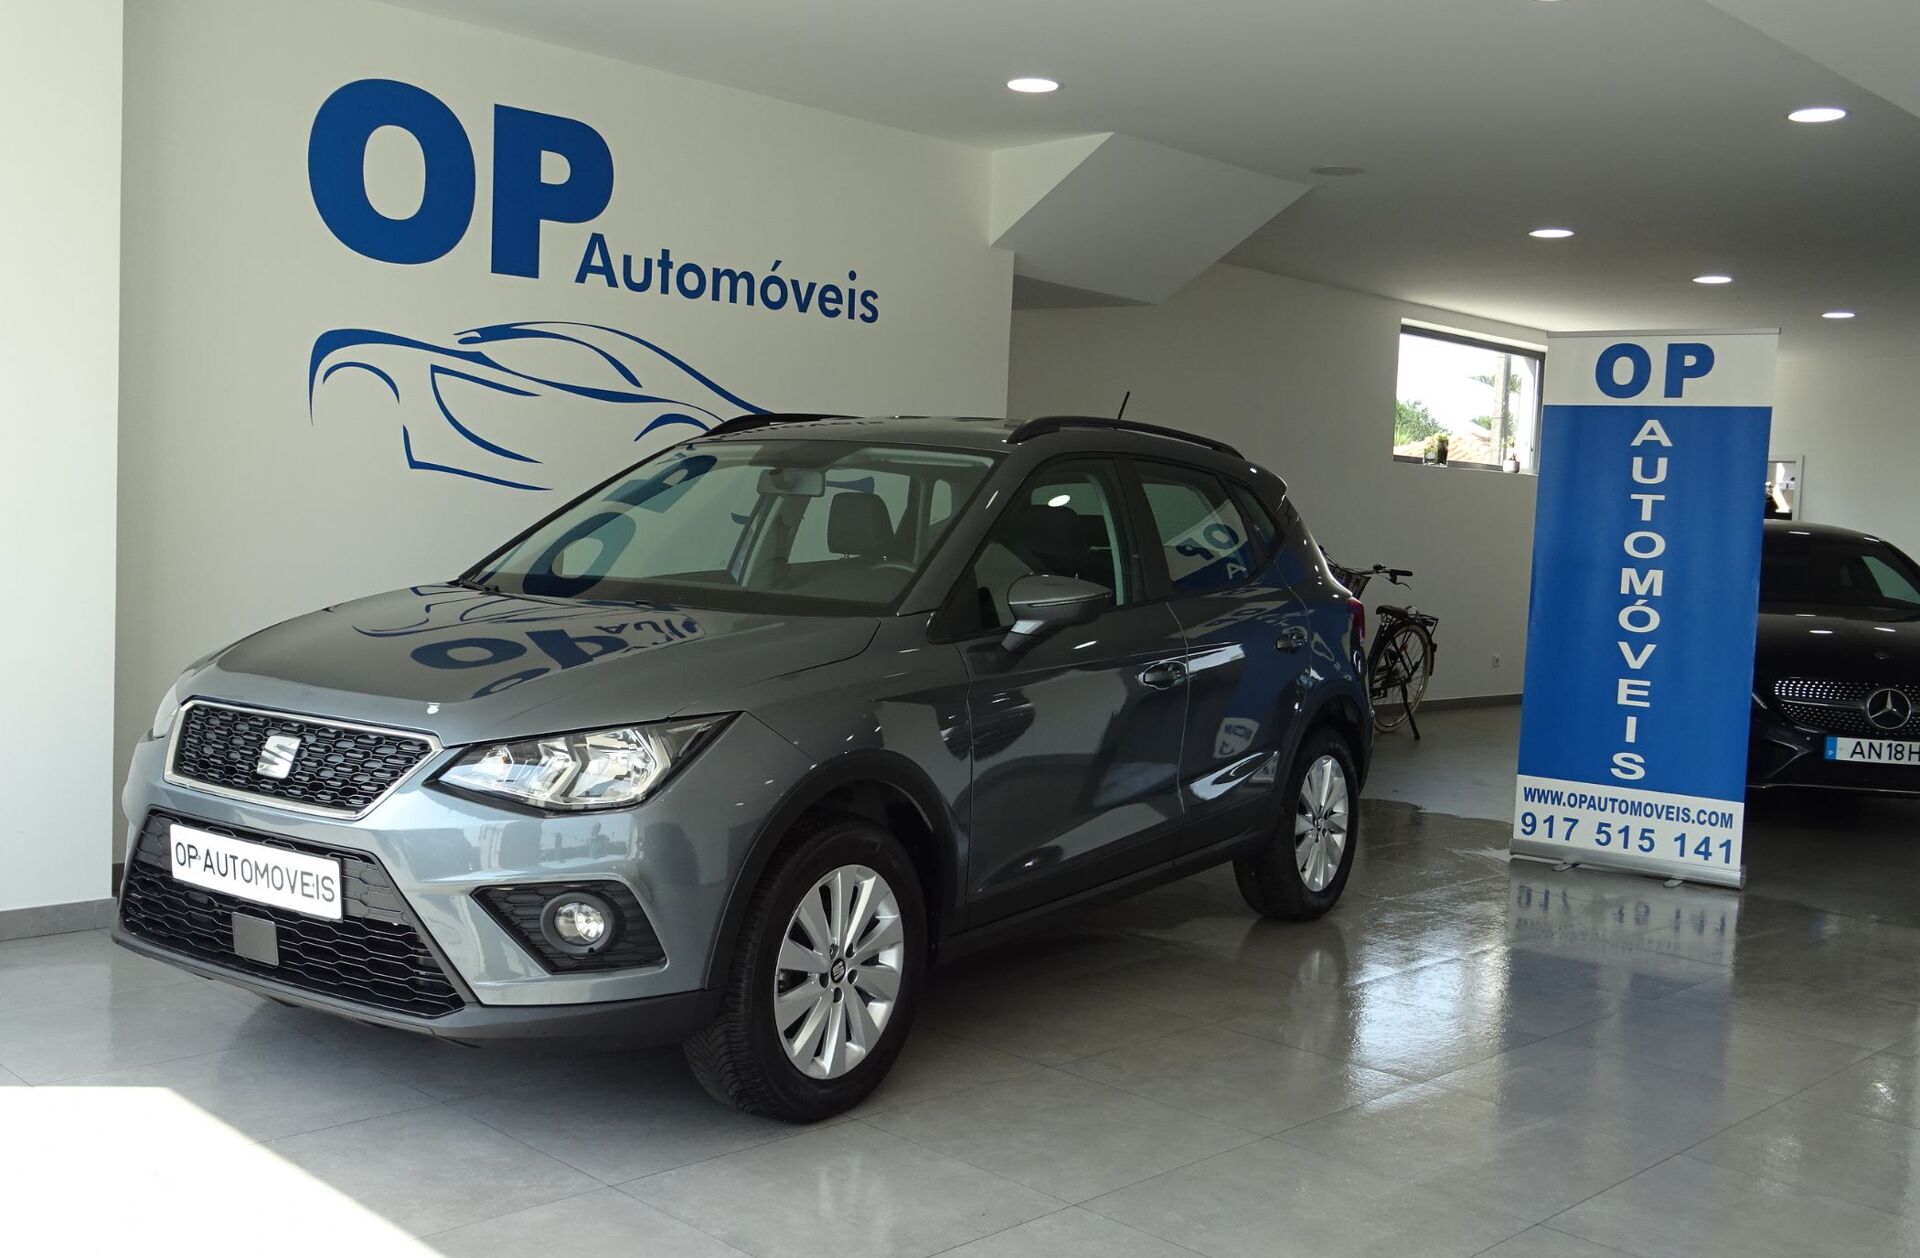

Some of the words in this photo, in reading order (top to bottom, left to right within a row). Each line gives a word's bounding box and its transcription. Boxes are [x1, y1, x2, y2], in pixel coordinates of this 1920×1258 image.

[308, 78, 613, 279] OP
[575, 232, 880, 324] Automóveis
[1595, 342, 1716, 399] OP
[1610, 419, 1673, 781] AUTOMÓVEIS
[1520, 811, 1579, 842] 917
[1595, 821, 1656, 853] 515
[1674, 832, 1733, 865] 141
[1523, 786, 1734, 830] WWW.OPAUTOMOVEIS.COM
